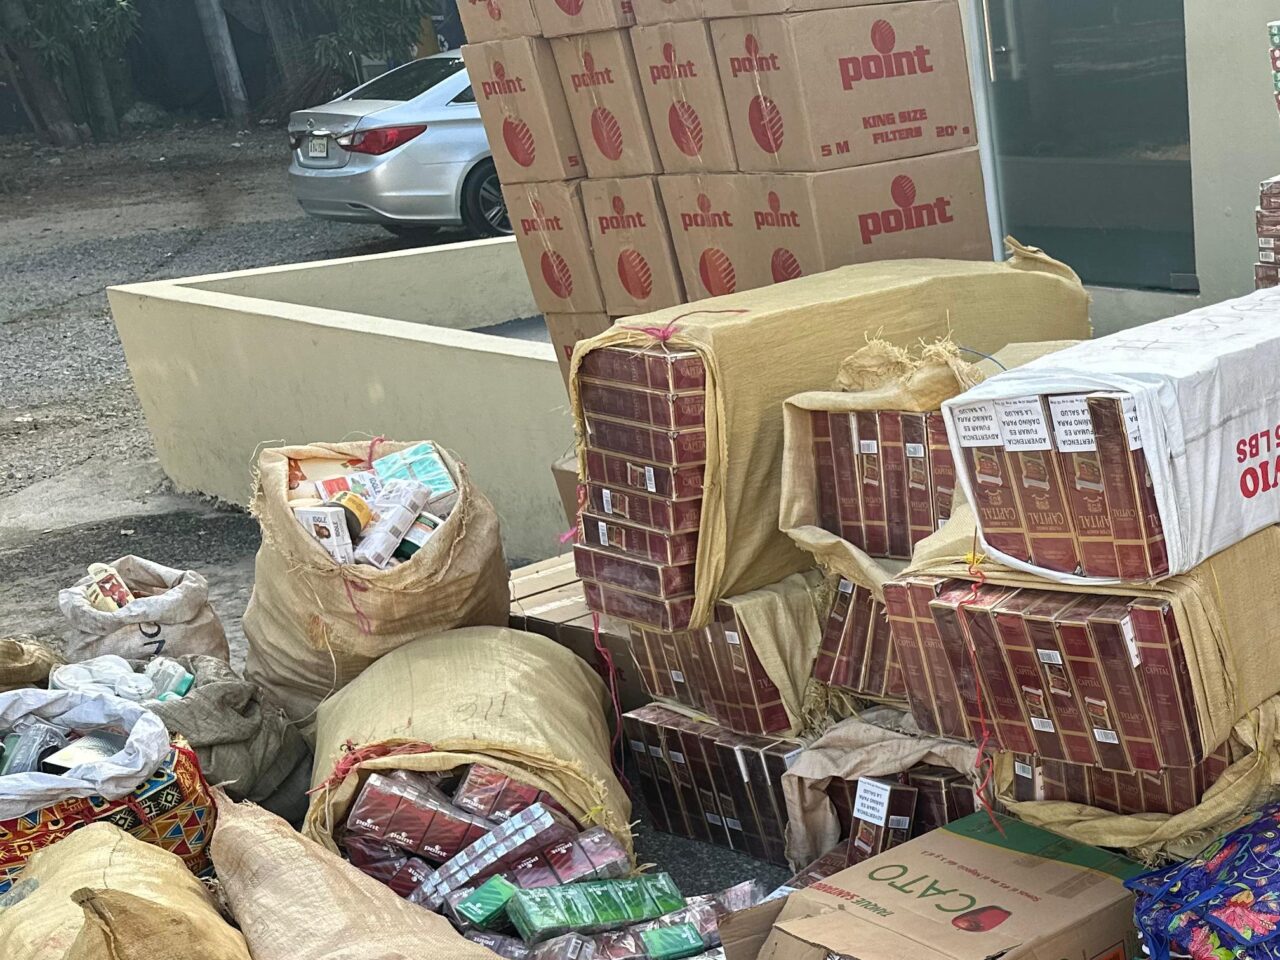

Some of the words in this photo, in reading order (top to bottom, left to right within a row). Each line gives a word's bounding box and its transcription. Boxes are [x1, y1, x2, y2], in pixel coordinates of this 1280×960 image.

[650, 61, 697, 84] point
[730, 53, 780, 77] point
[839, 45, 933, 90] point
[571, 67, 614, 92] point
[862, 113, 895, 129] KING
[899, 109, 928, 123] SIZE
[873, 126, 922, 144] FILTERS
[821, 145, 832, 157] 5
[836, 141, 849, 154] M
[599, 211, 646, 234] point
[681, 210, 733, 231] point
[754, 209, 800, 230] point
[858, 197, 953, 244] point
[1236, 430, 1270, 463] LBS
[981, 508, 1016, 520] CAPITAL
[1028, 512, 1064, 525] CAPITAL
[868, 864, 977, 913] CATO
